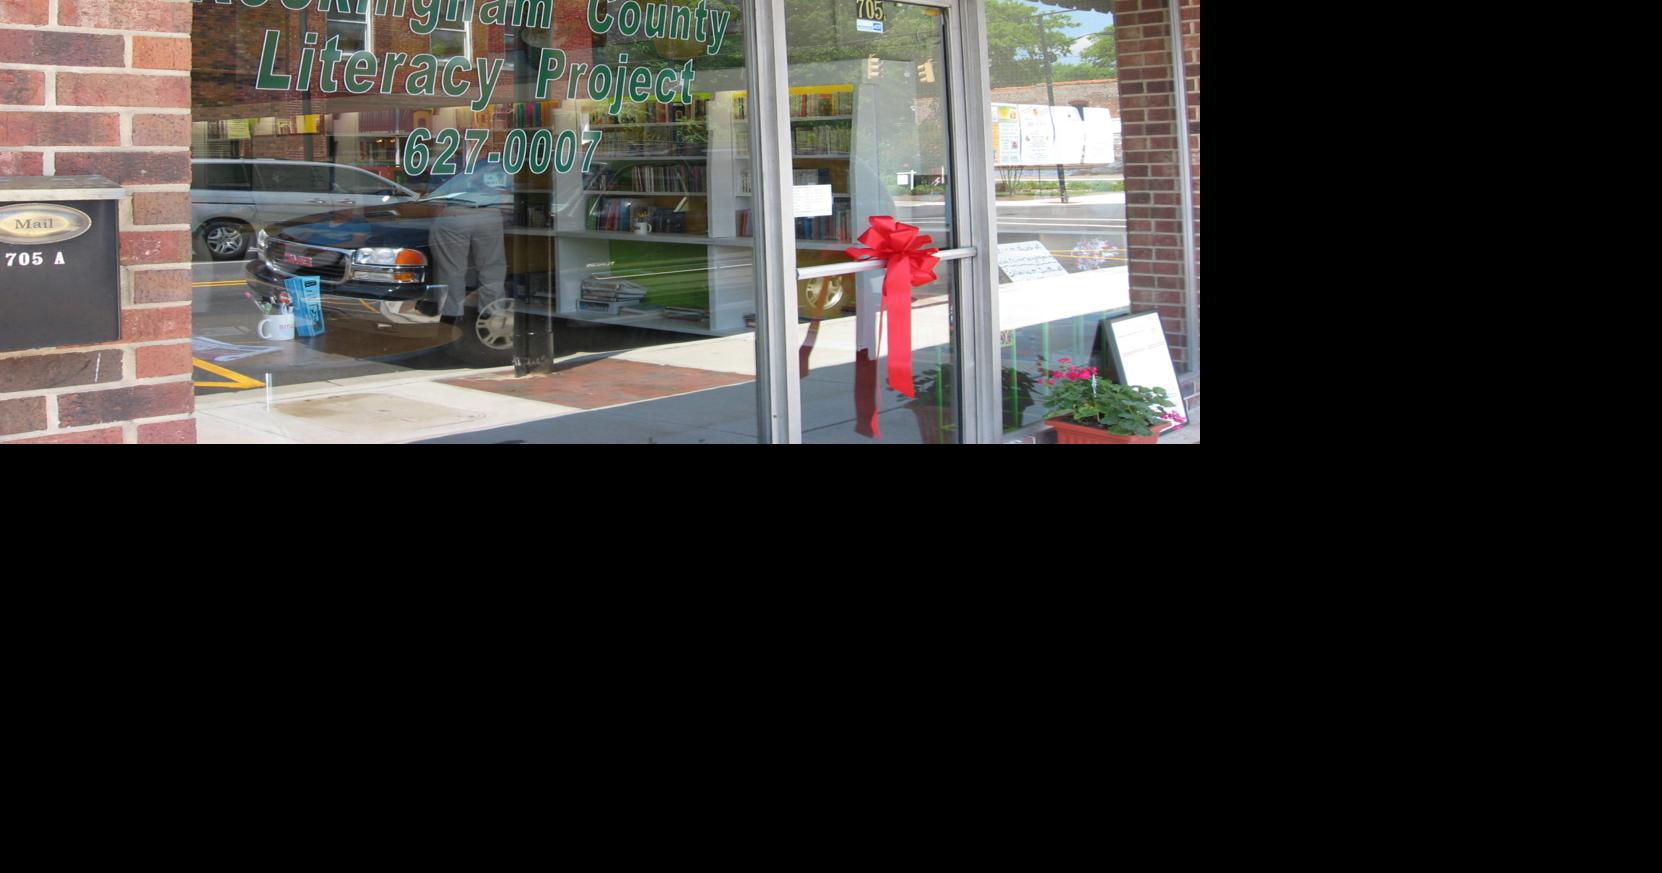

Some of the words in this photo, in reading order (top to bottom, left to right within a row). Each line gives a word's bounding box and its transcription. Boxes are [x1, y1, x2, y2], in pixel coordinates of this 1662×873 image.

[856, 0, 883, 20] 705
[587, 0, 730, 55] County
[255, 29, 505, 112] Literacy
[535, 47, 696, 116] Project
[403, 127, 603, 176] 627-0007
[15, 217, 54, 230] Mail
[5, 251, 44, 267] 705
[53, 251, 66, 265] A
